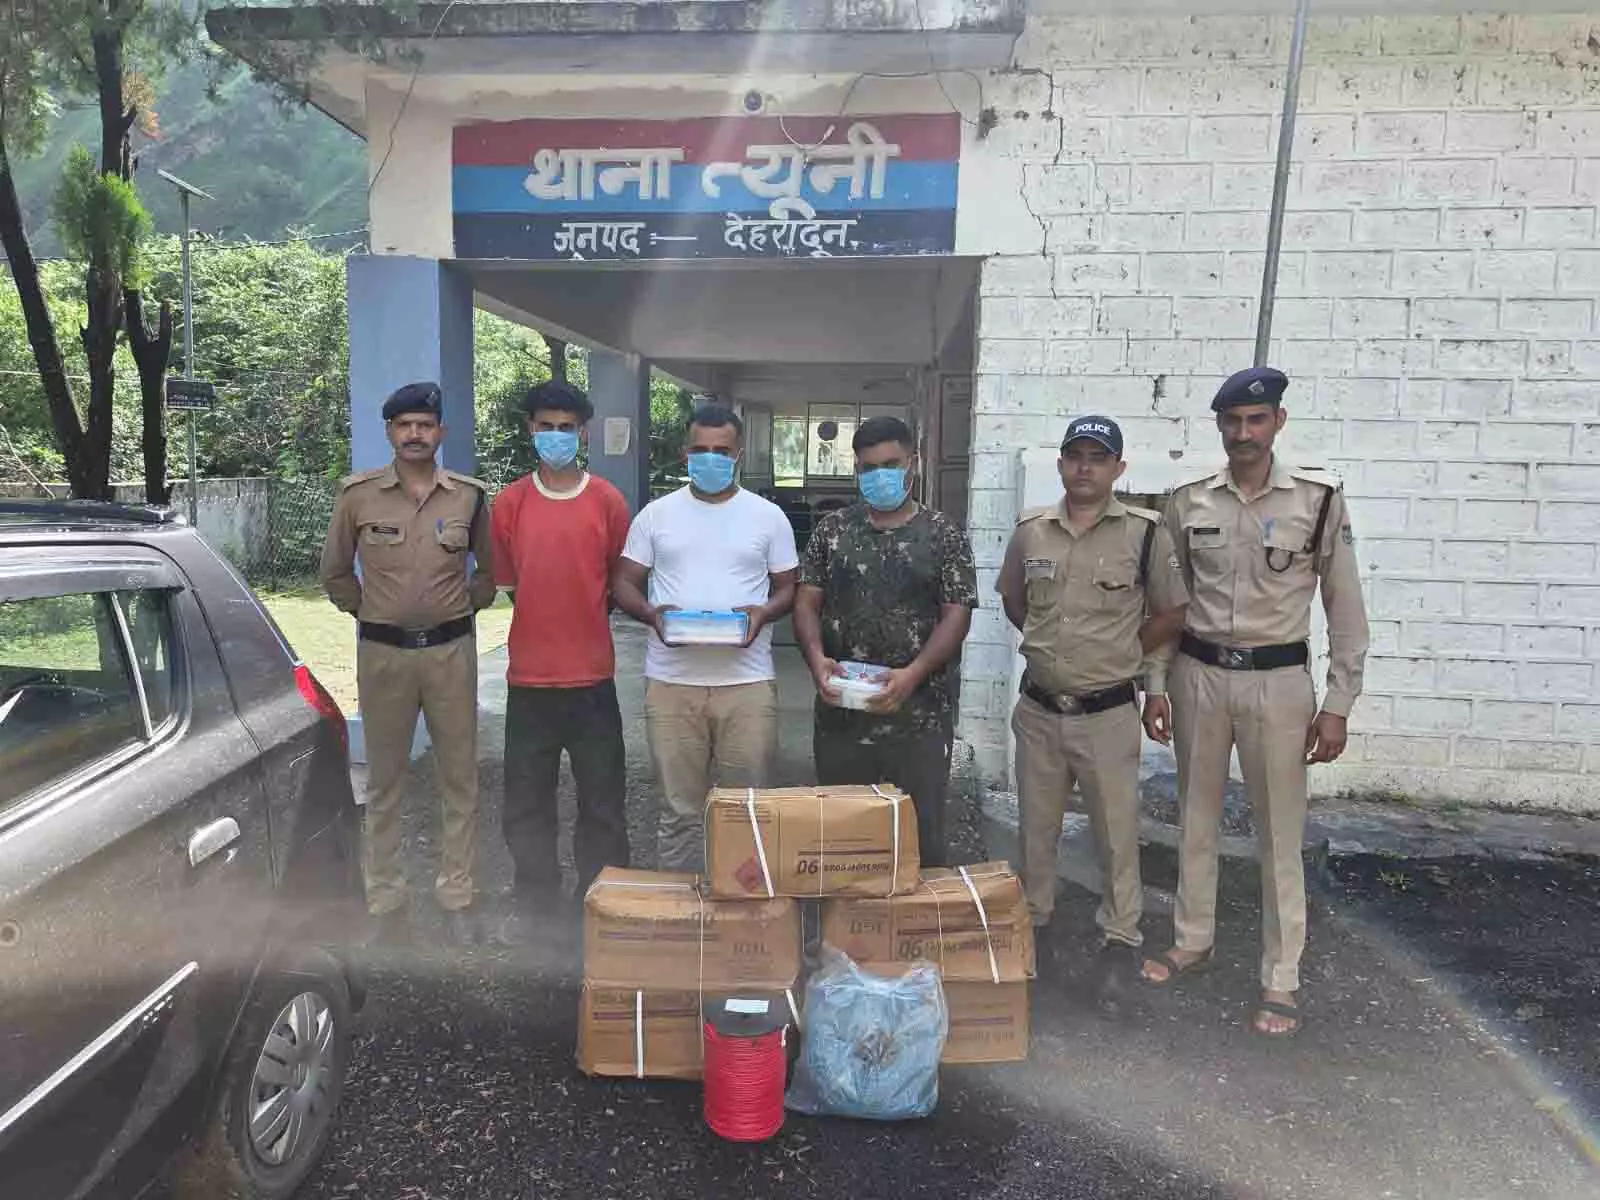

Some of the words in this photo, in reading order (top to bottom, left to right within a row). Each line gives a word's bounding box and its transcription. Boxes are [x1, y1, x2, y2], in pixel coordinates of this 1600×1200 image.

[524, 147, 685, 200] थाना
[702, 122, 900, 220] त्यूनी
[553, 221, 646, 255] जनपद
[1074, 423, 1111, 436] POLICE
